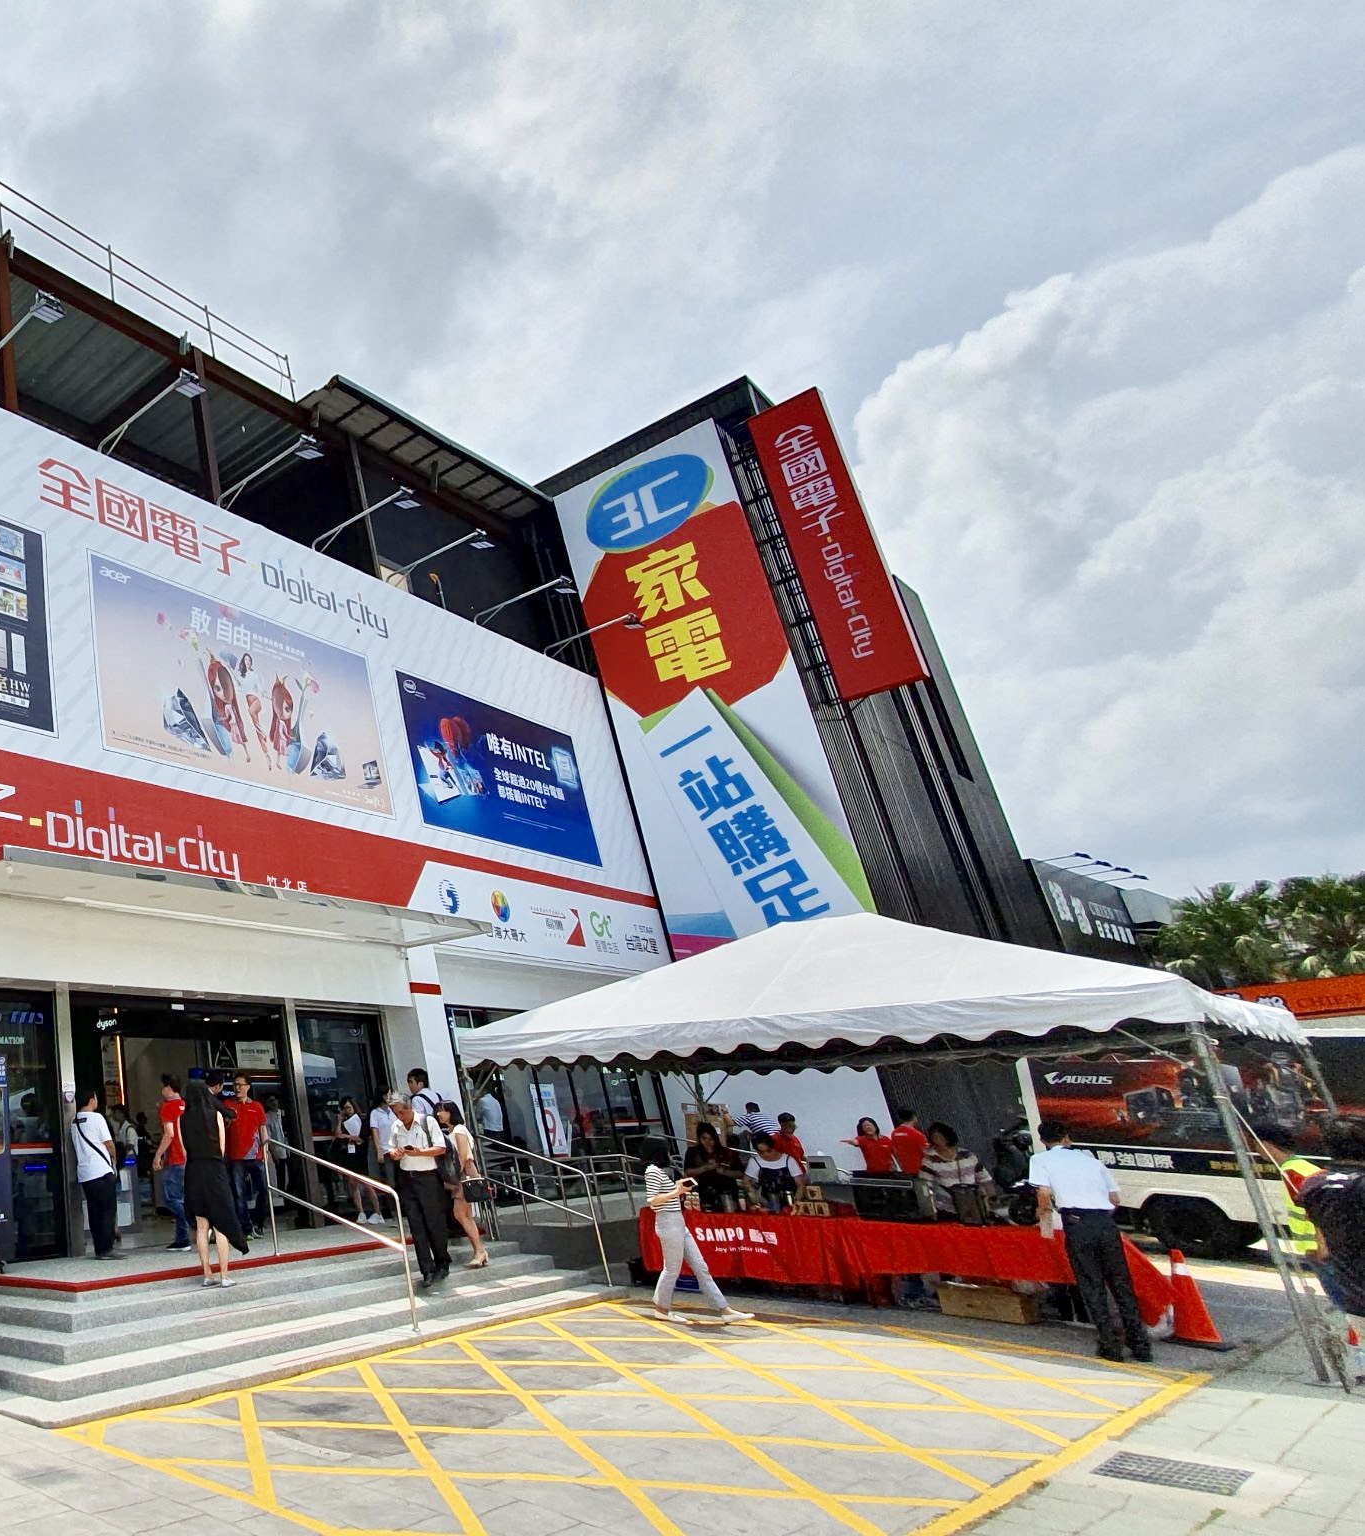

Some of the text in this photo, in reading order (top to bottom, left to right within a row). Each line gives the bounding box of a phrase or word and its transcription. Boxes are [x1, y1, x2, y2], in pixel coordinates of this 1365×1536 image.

[774, 424, 846, 537] 全國電子
[38, 457, 247, 577] 全國電子
[602, 470, 690, 541] 3C
[99, 565, 132, 585] acer
[625, 541, 732, 683] 家電
[216, 617, 251, 652] 自由
[10, 679, 31, 693] HW
[660, 725, 830, 928] 一站購足
[96, 1018, 117, 1031] dyson
[1060, 1075, 1114, 1085] AORUS
[695, 1227, 744, 1242] SAMPO
